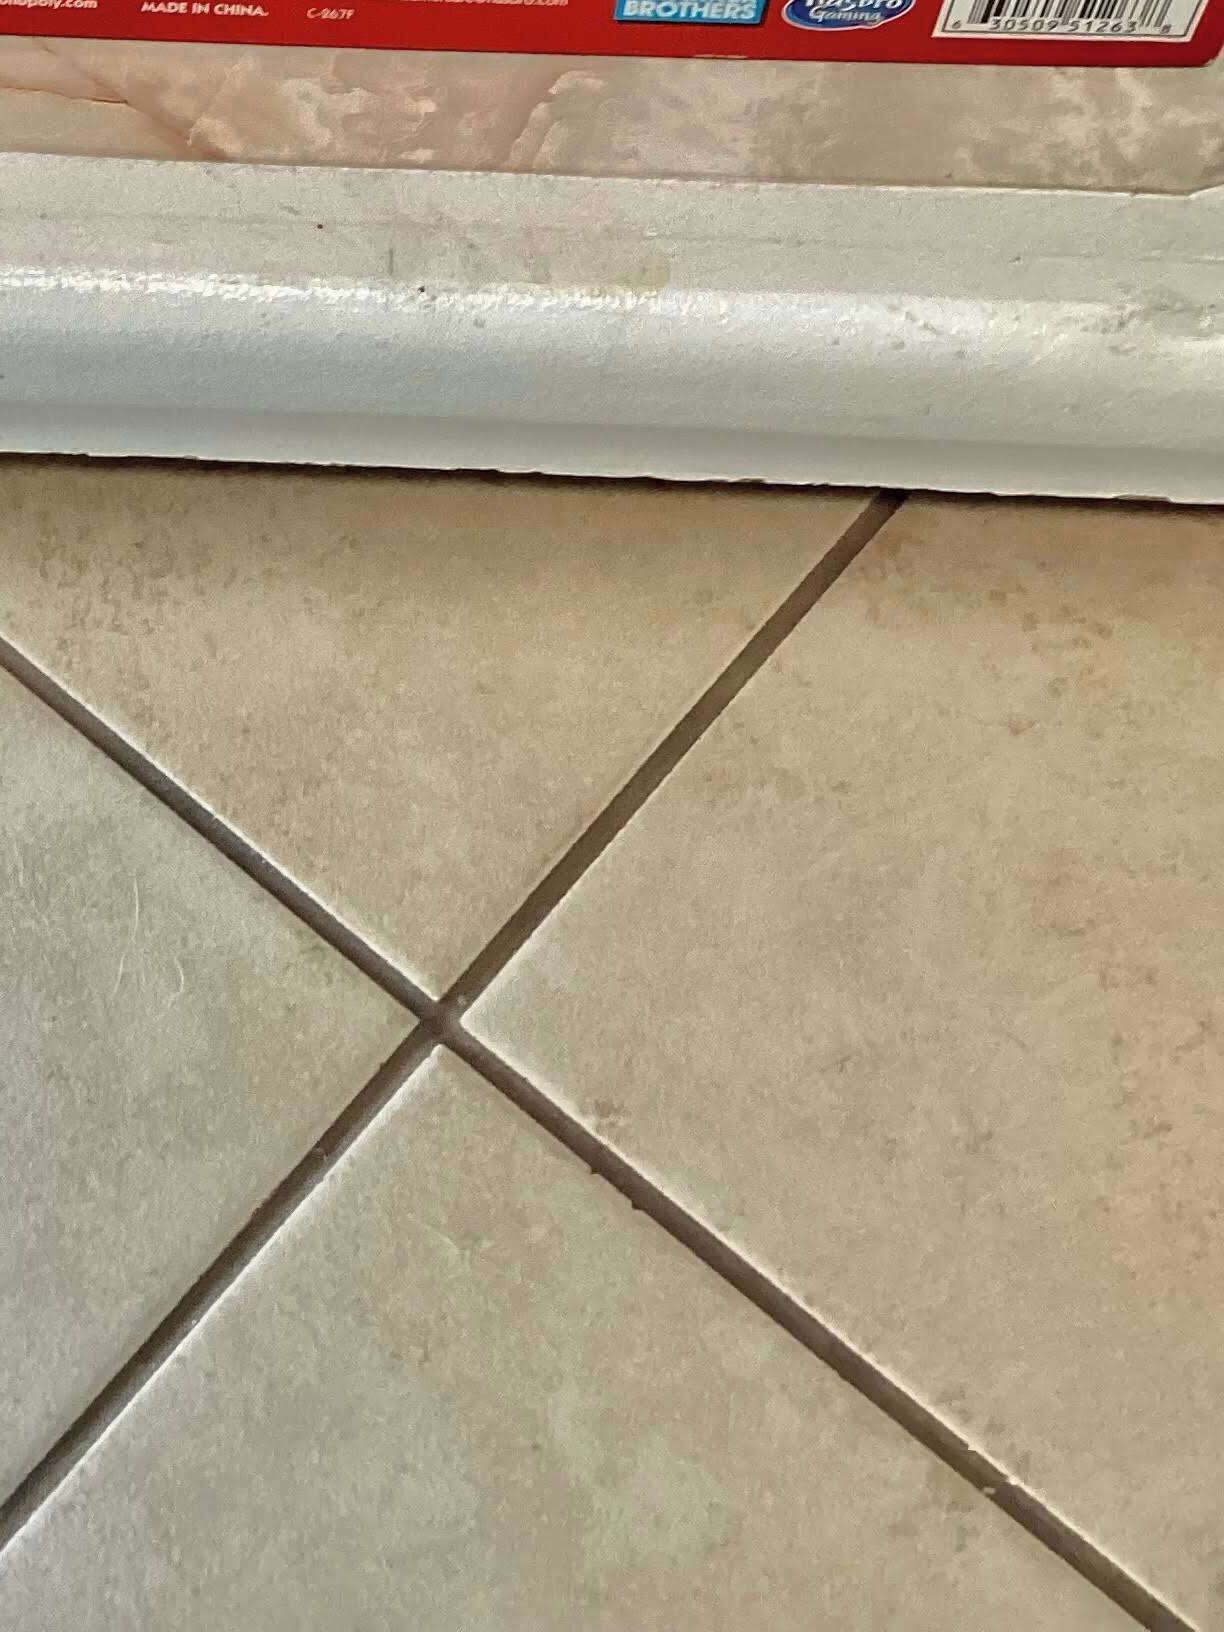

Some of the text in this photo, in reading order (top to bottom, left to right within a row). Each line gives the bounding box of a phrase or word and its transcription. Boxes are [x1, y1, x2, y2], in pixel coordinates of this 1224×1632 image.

[141, 1, 188, 14] MADE
[192, 2, 209, 14] IN
[214, 3, 270, 17] CHINA.
[622, 0, 758, 20] BROTHERS
[809, 6, 883, 24] Gaming
[991, 19, 1057, 32] 30509
[1069, 20, 1138, 33] 51263
